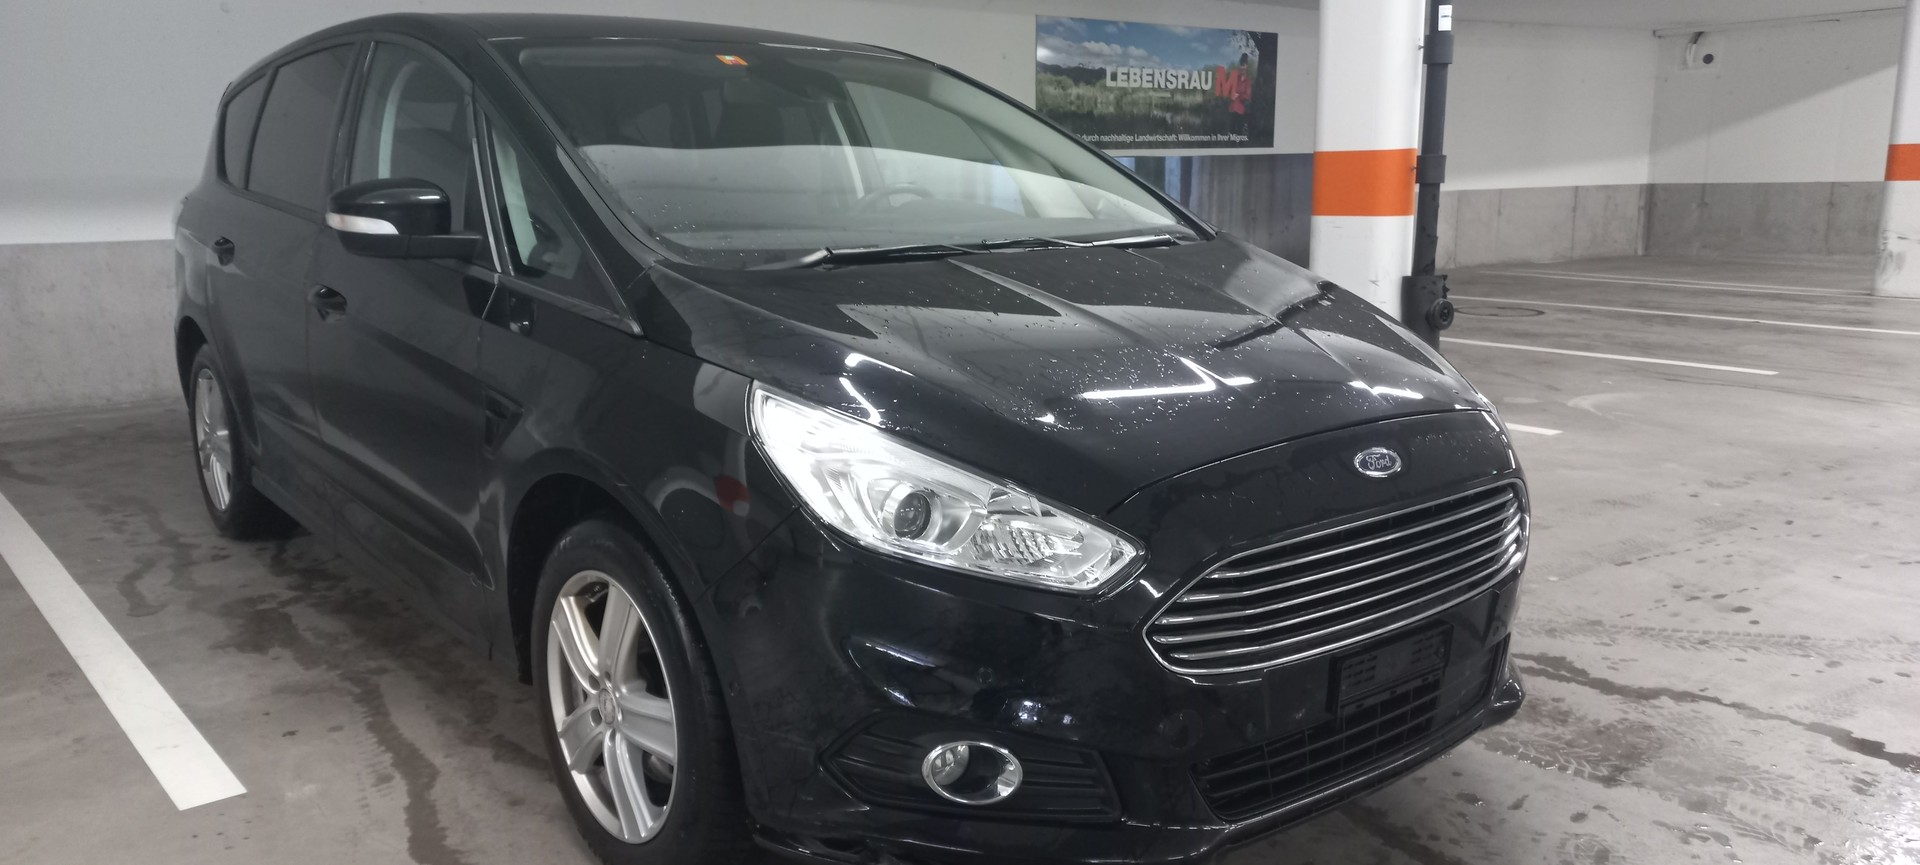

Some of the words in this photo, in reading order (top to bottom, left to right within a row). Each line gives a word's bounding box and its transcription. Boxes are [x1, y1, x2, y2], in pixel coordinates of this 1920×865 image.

[1100, 133, 1133, 143] nachhaltige
[1211, 133, 1216, 141] in
[1217, 133, 1229, 141] Ihrer
[1366, 454, 1391, 470] Ford
